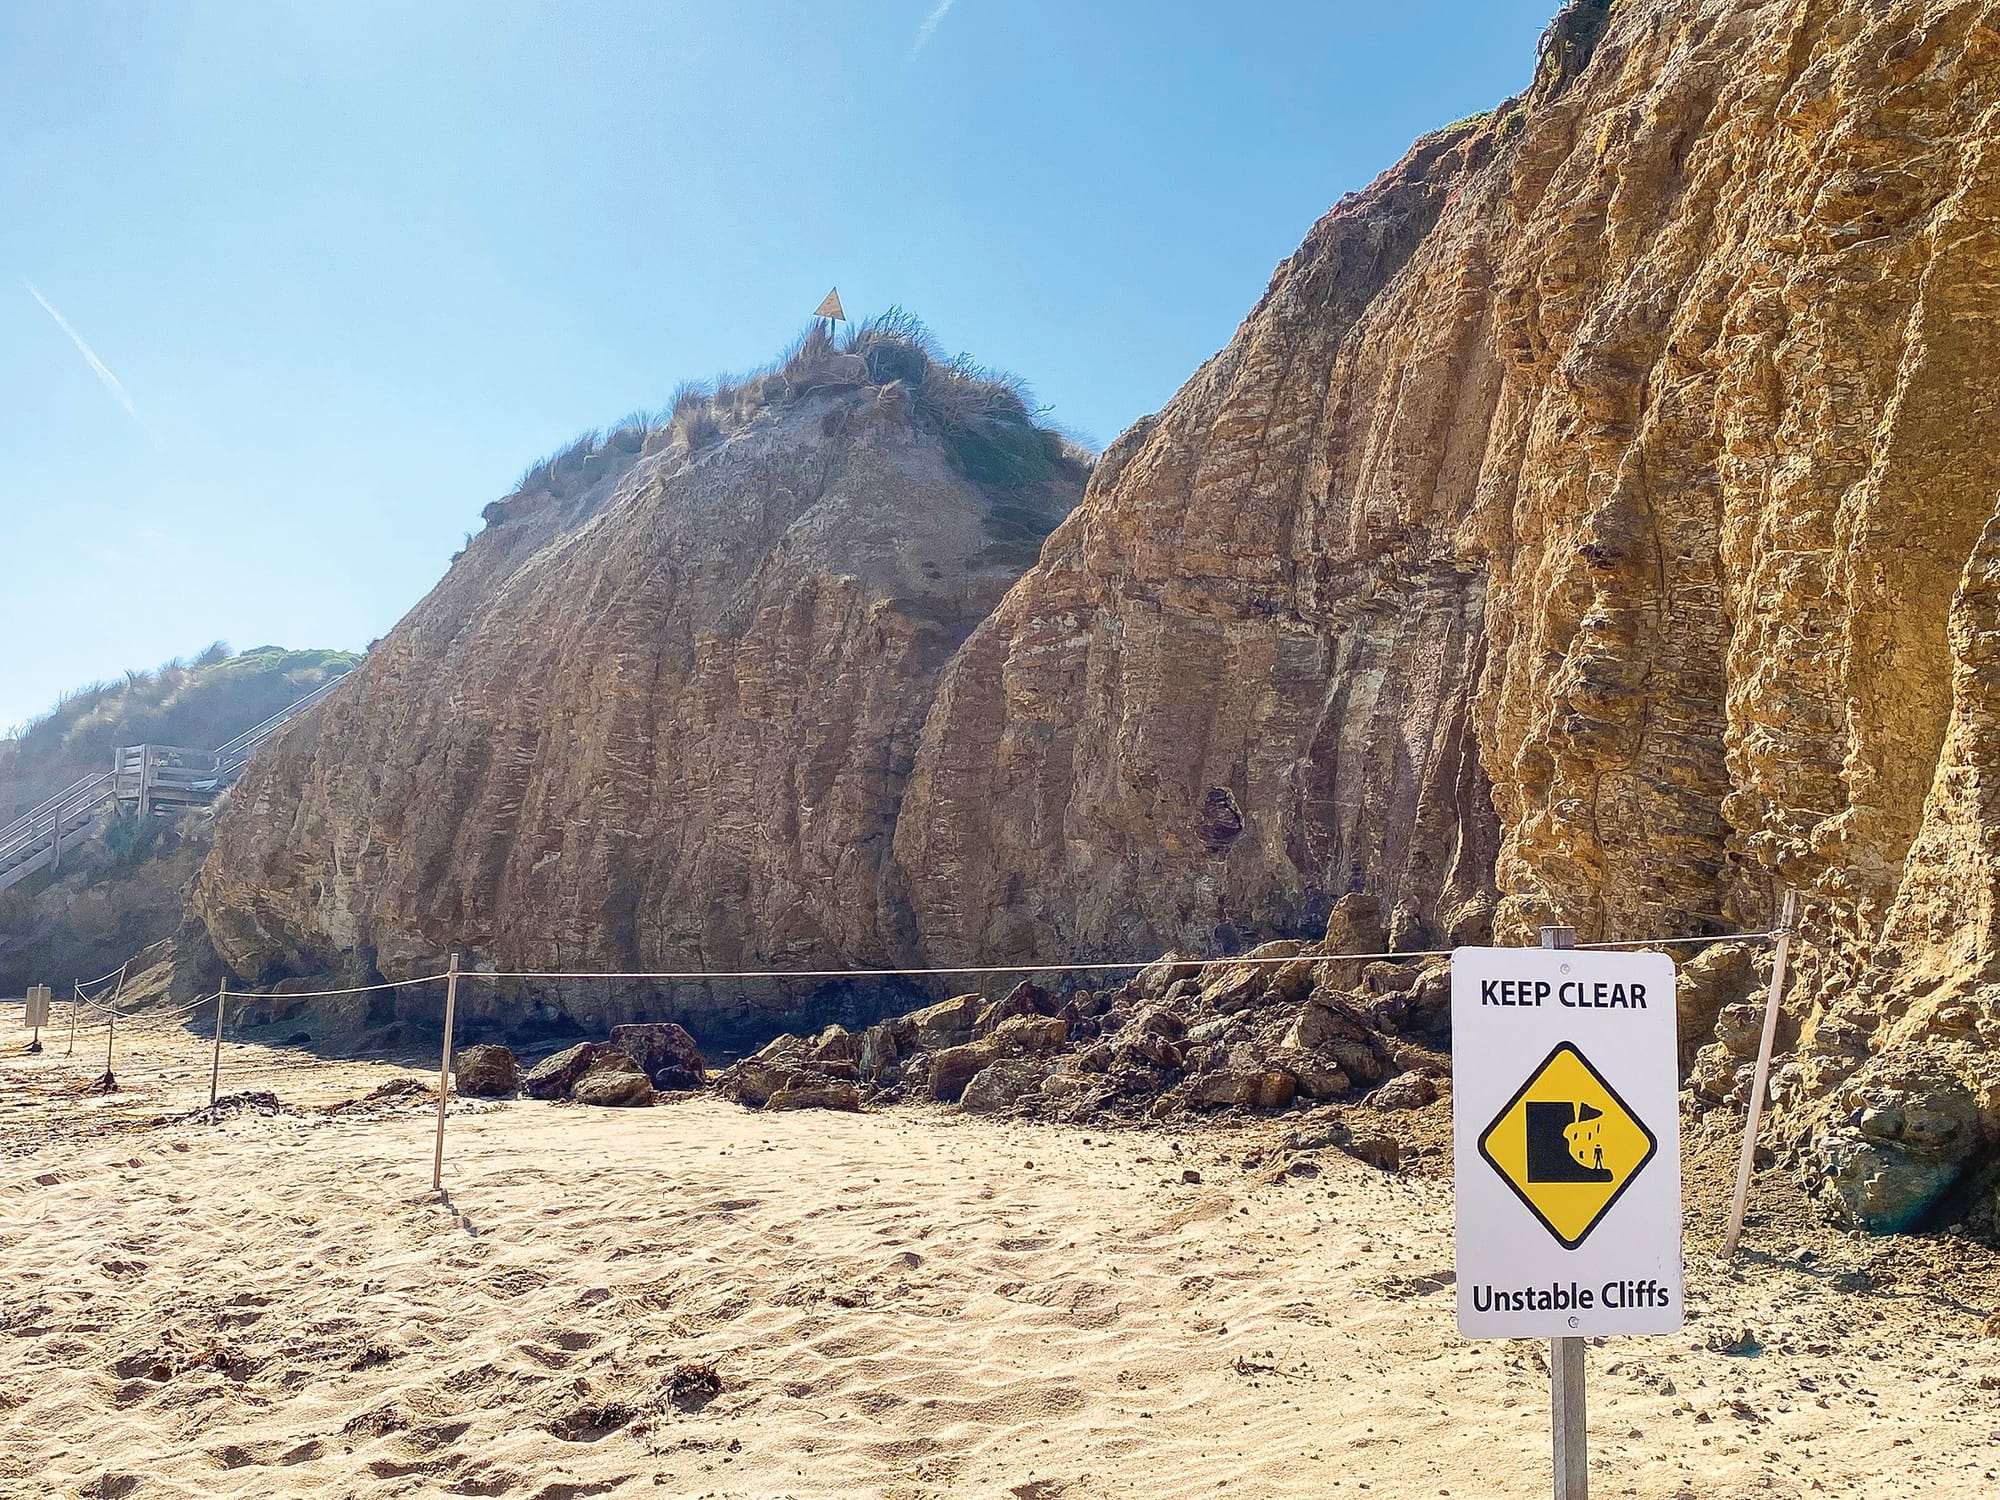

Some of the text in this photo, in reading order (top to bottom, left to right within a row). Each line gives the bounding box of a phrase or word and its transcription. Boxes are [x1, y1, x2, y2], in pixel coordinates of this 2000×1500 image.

[1481, 979, 1648, 1009] KEEP CLEAR
[1473, 1279, 1670, 1313] Unstable Cliffs
